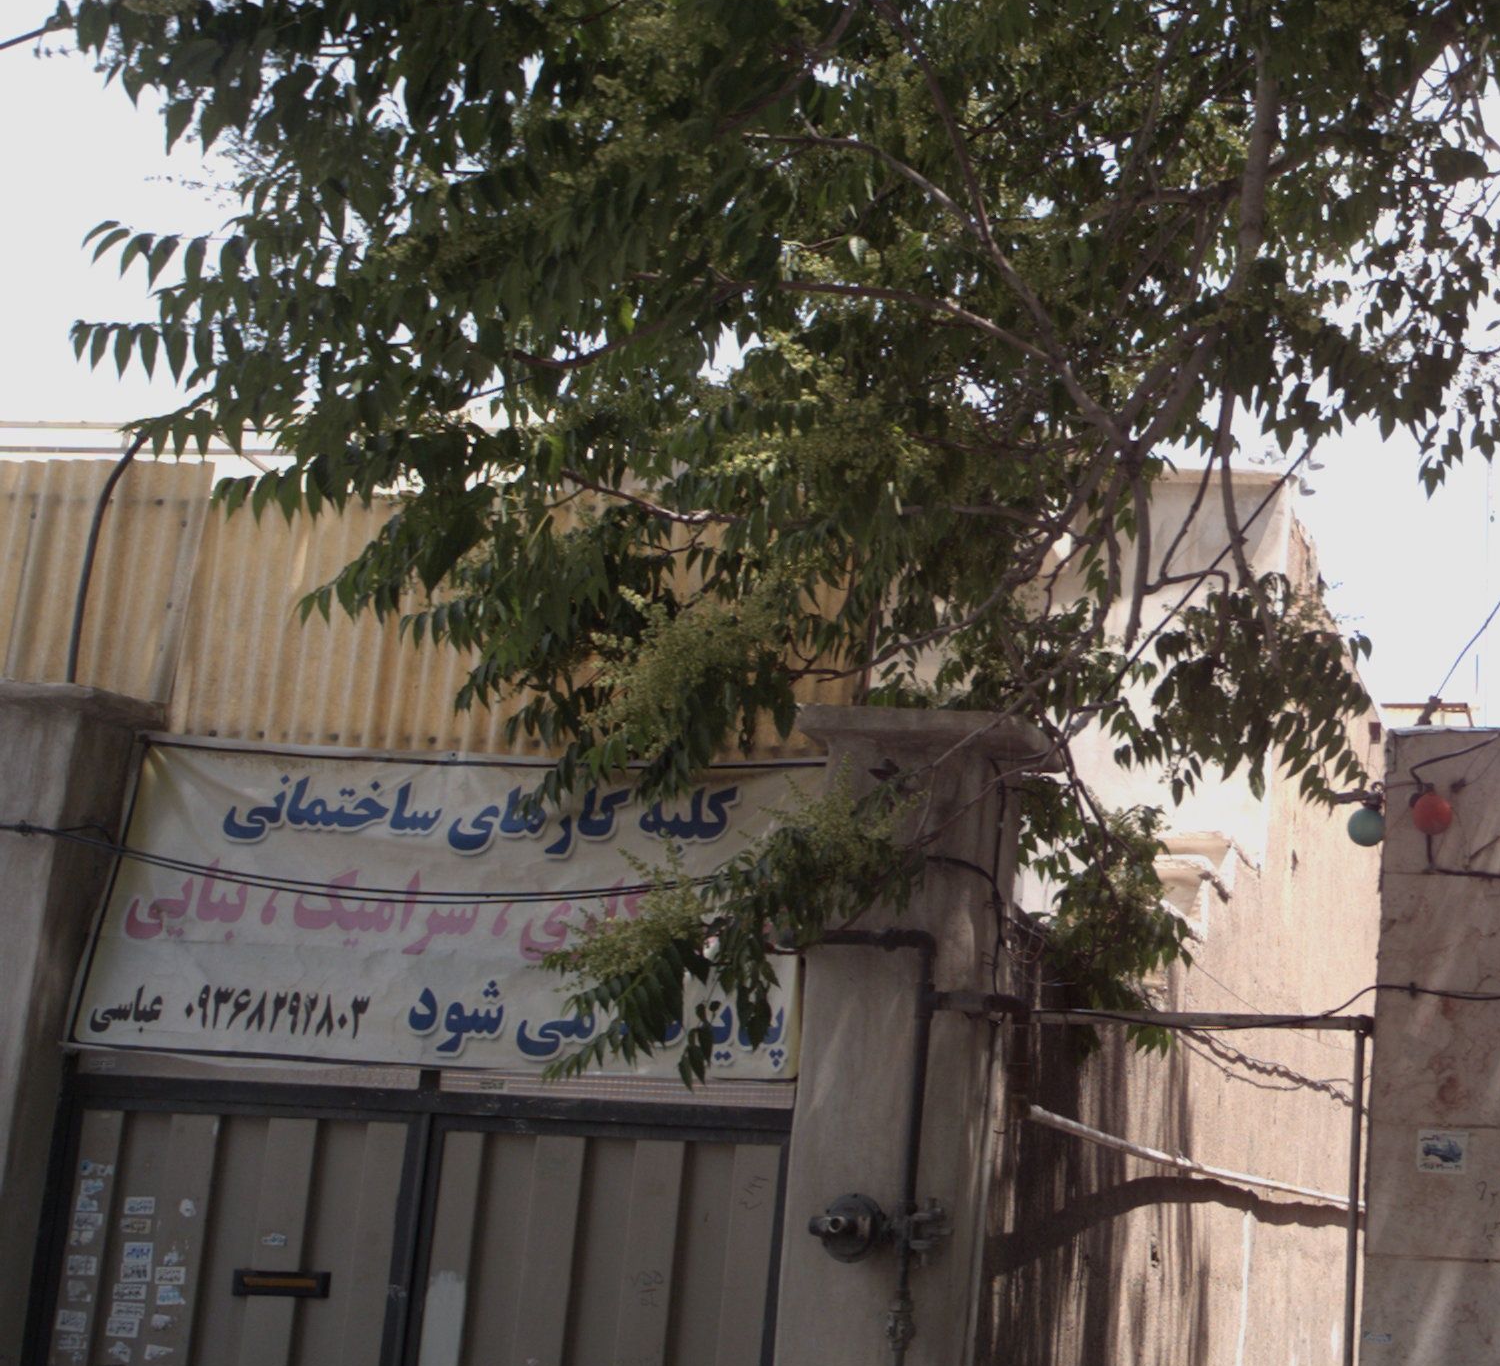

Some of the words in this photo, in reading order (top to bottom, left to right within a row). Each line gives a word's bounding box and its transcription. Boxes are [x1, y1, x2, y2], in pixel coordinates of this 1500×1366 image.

[222, 775, 443, 840] ساختمانی
[638, 786, 738, 854] کلیه
[124, 857, 249, 940] بنایی
[89, 985, 164, 1033] عباسی
[407, 979, 505, 1053] شود
